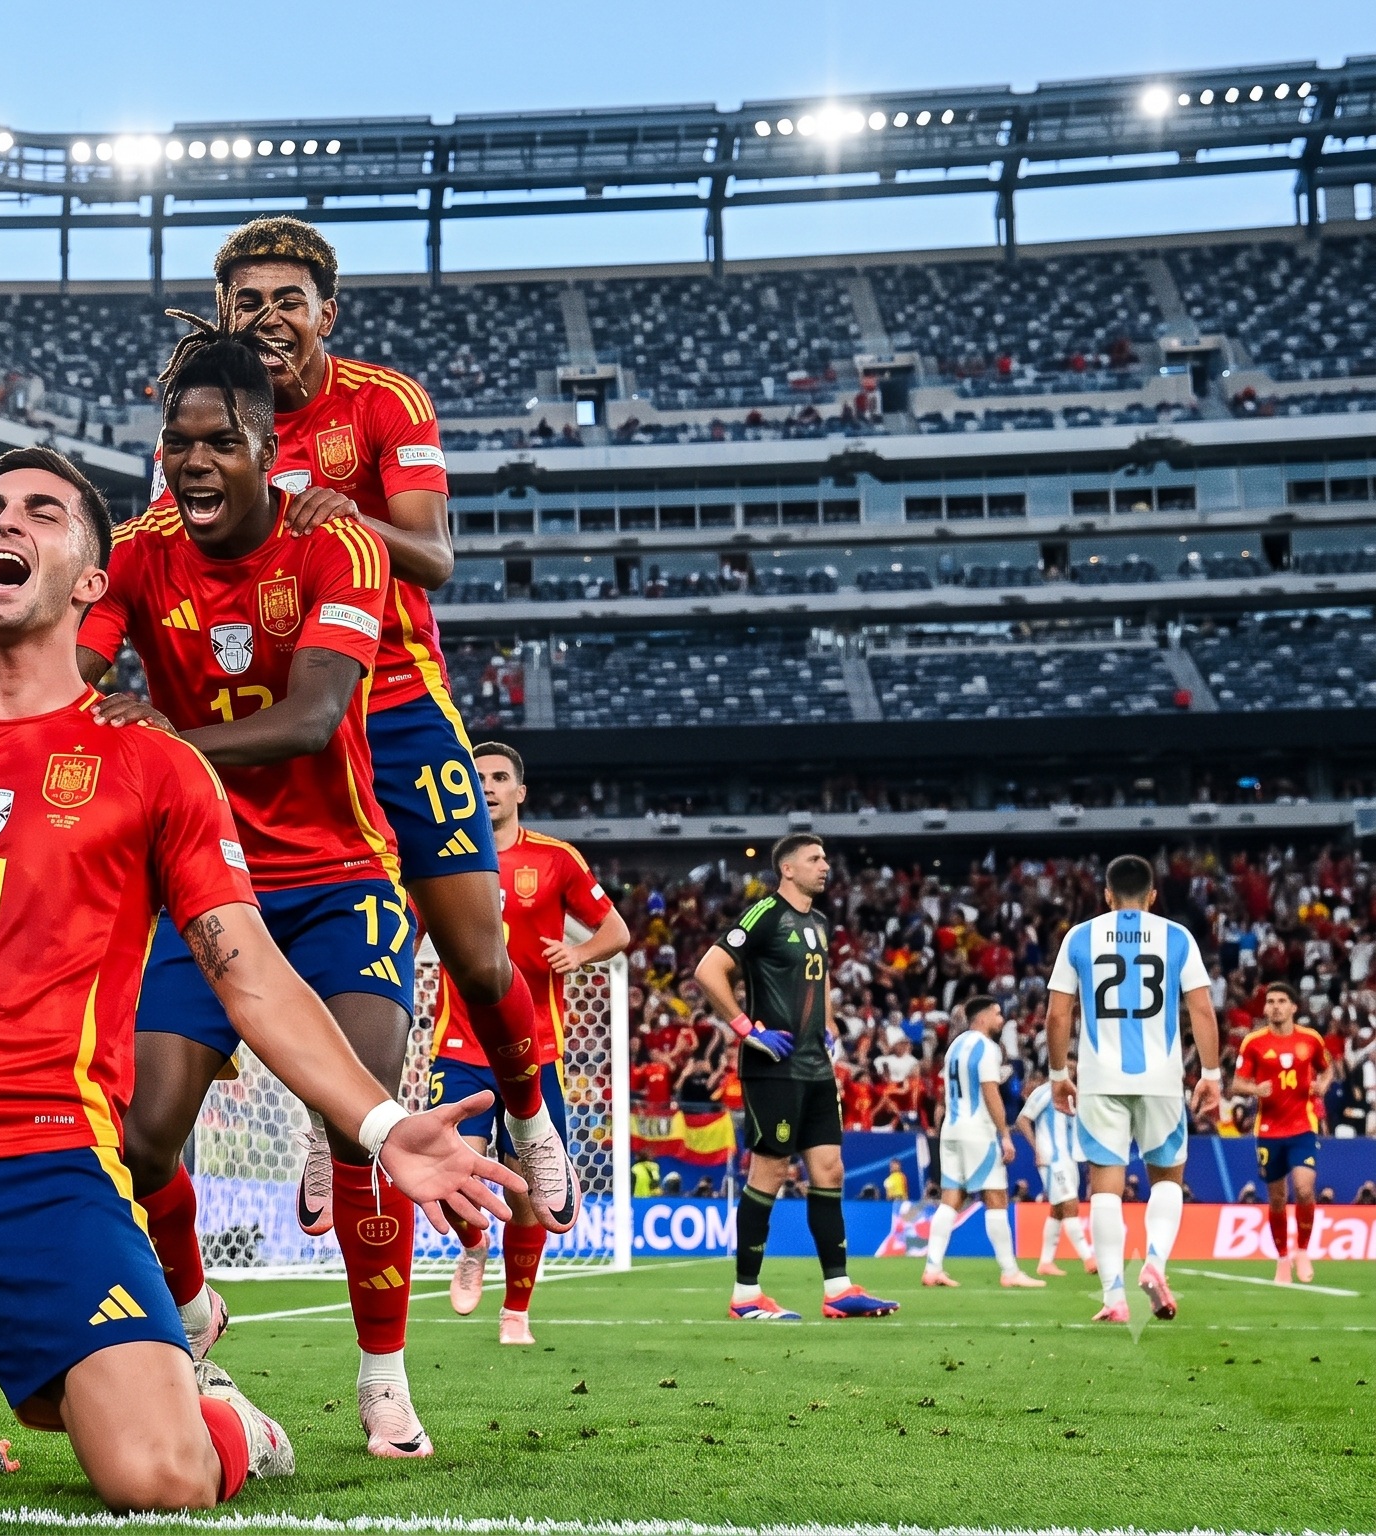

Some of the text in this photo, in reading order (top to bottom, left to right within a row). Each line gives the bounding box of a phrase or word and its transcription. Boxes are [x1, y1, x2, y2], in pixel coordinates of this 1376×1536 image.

[414, 759, 477, 824] 19
[805, 952, 823, 980] 23
[1094, 953, 1164, 1019] 23
[428, 1071, 445, 1105] 5
[1277, 1069, 1298, 1090] 14
